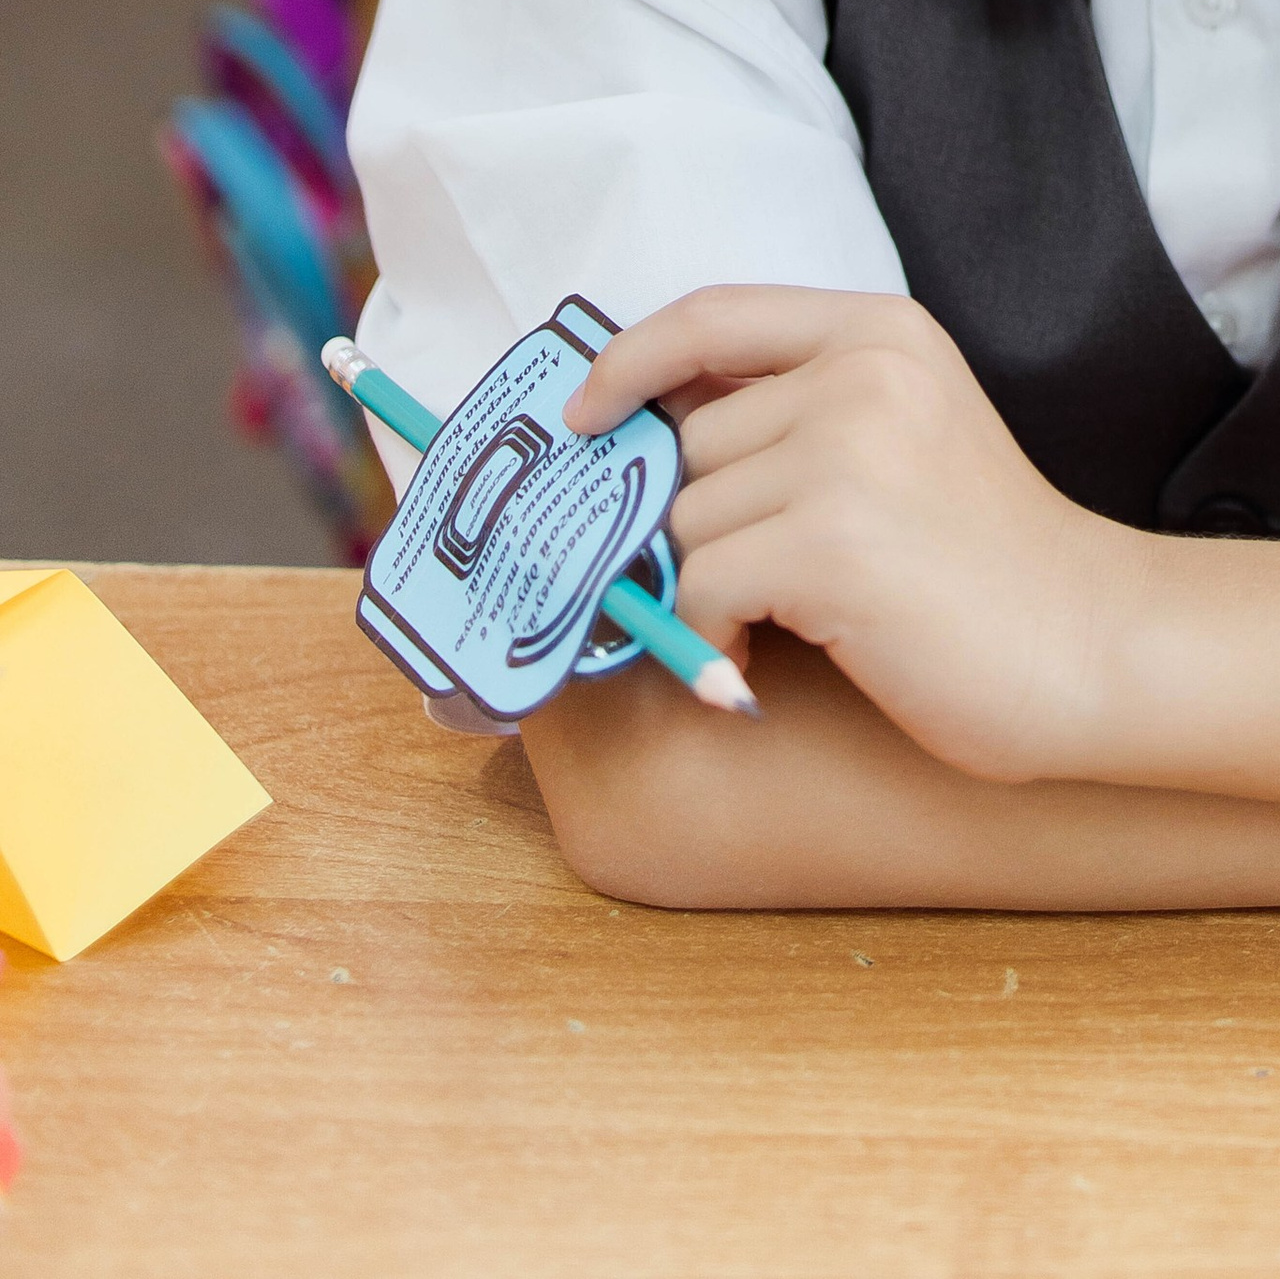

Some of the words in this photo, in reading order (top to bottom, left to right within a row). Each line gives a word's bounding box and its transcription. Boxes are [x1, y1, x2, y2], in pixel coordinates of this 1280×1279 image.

[513, 346, 551, 386] Твоя
[537, 367, 548, 381] я
[550, 349, 561, 368] А
[463, 385, 512, 443] первая
[464, 368, 510, 421] Елена
[490, 381, 536, 432] всегда
[397, 420, 465, 539] Васильевна!
[452, 433, 489, 487] приду
[469, 469, 493, 510] пути!
[515, 431, 581, 506] Страну
[521, 435, 599, 523] ешествие
[392, 440, 463, 570] учительница
[437, 488, 452, 515] на
[519, 432, 618, 558] Приглашаю
[539, 466, 612, 559] дорогой
[465, 506, 513, 605] Знаний!
[522, 486, 624, 636] Здравствуй,
[454, 540, 511, 652] волшебную
[488, 560, 520, 622] тебя
[506, 562, 540, 634] друг!
